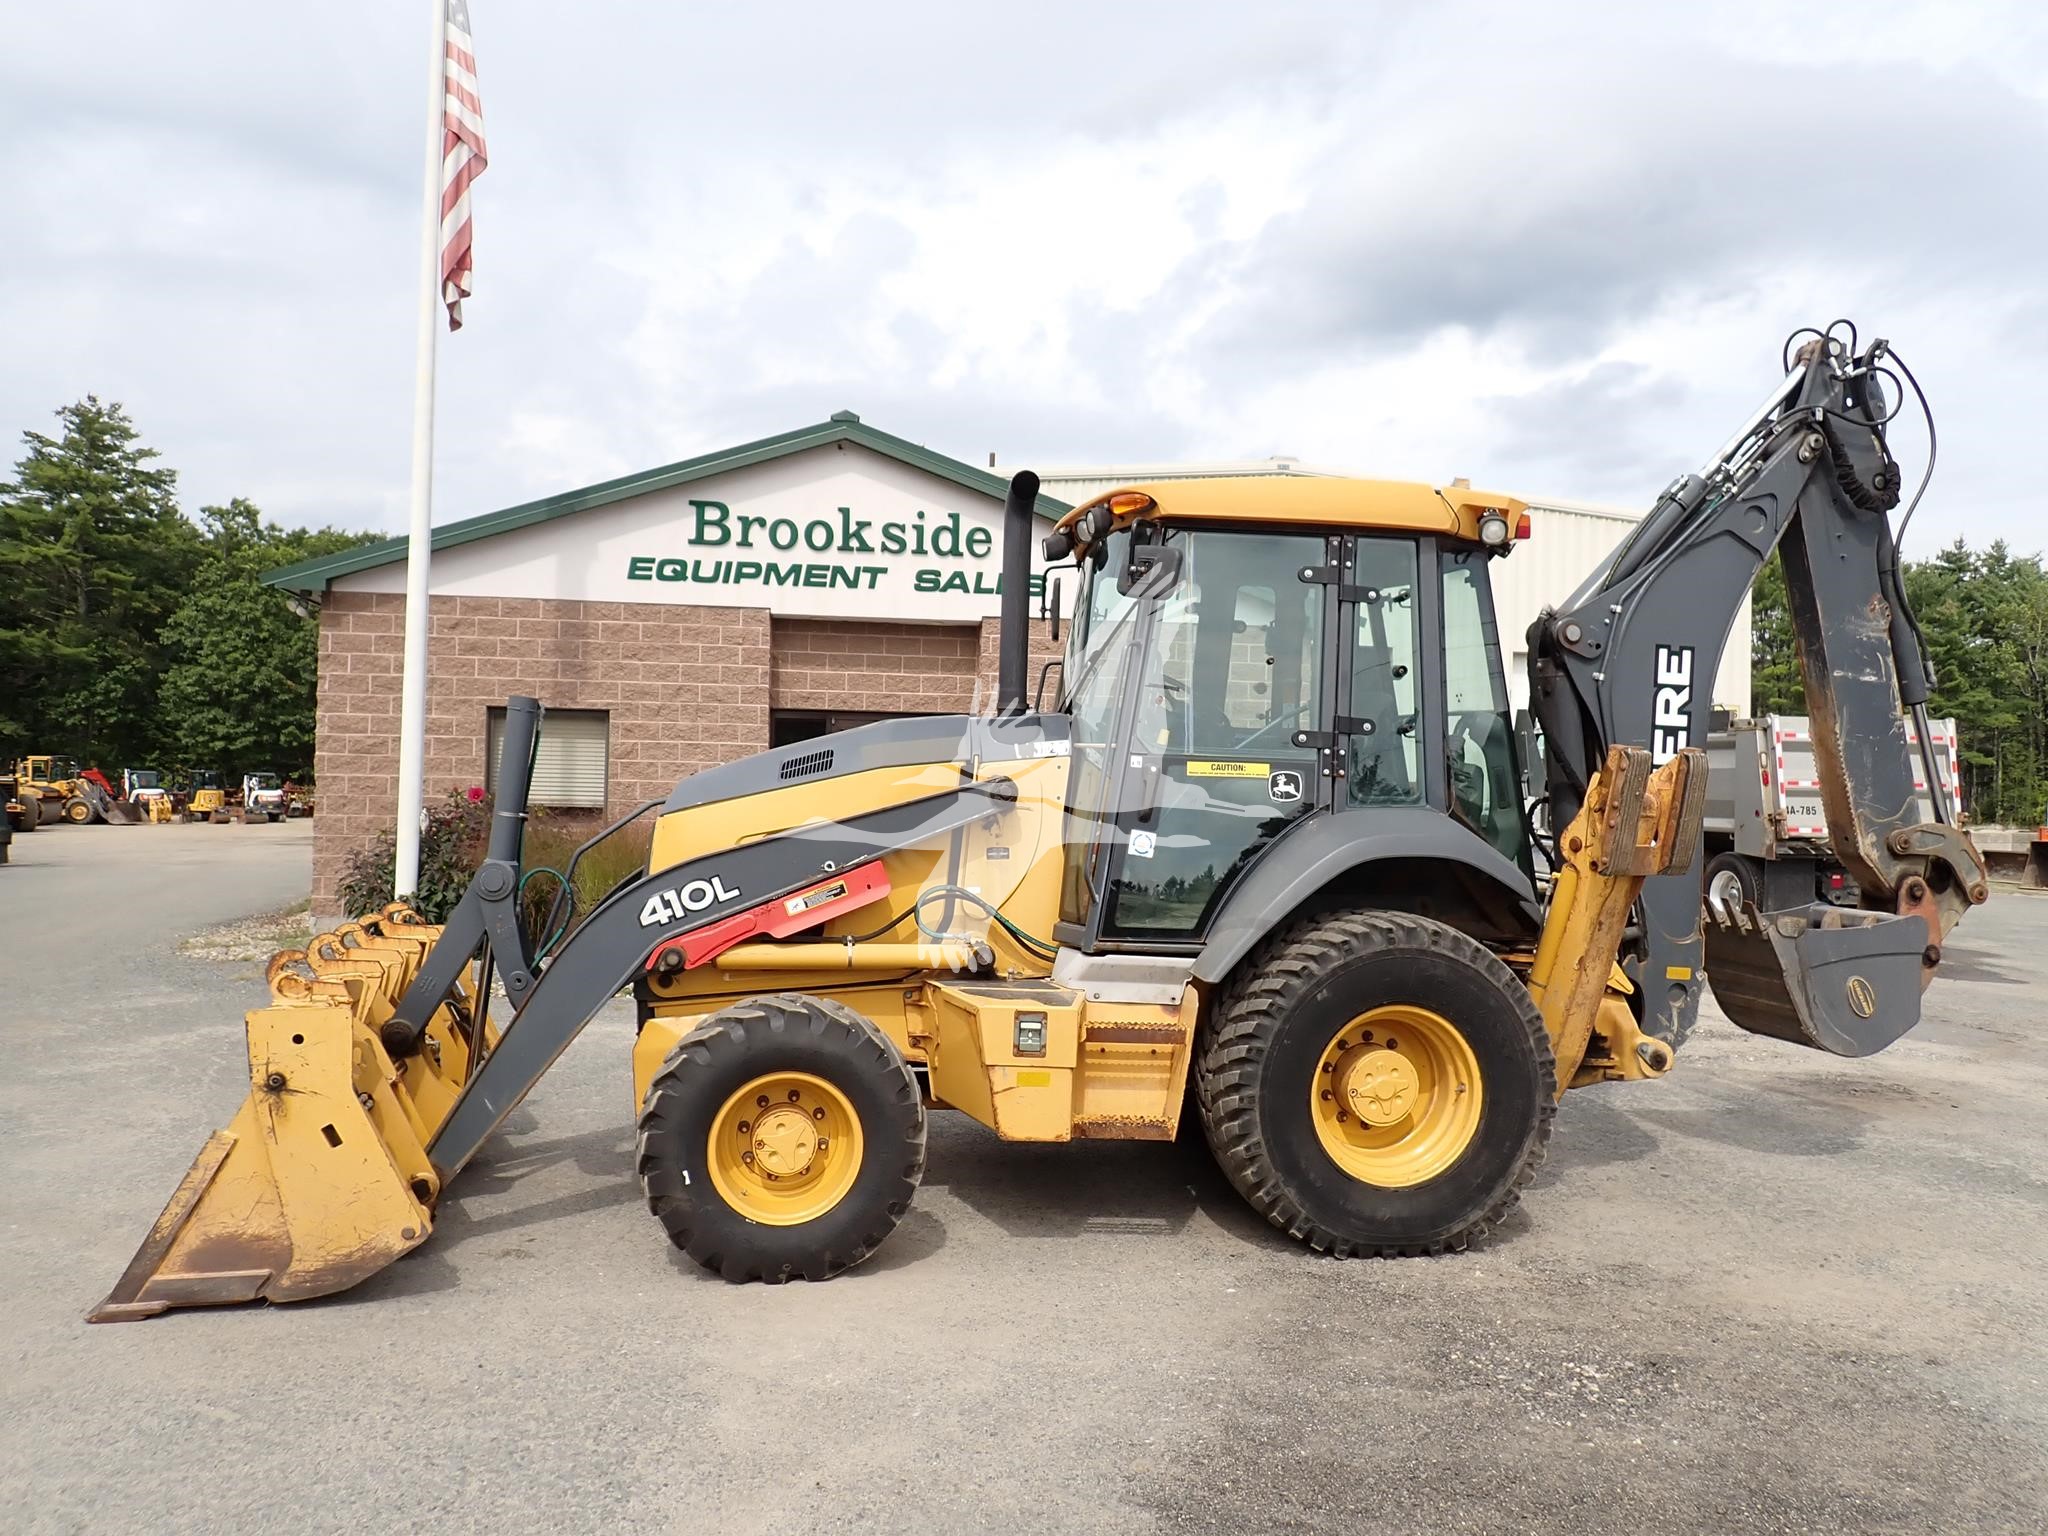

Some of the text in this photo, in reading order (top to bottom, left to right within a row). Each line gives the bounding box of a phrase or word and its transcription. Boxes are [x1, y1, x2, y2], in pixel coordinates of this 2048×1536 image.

[687, 499, 993, 559] Brookside
[627, 556, 888, 590] EQUIPMENT
[1651, 646, 1693, 772] ERE
[1210, 763, 1247, 772] CAUTION:
[639, 875, 741, 927] 410L
